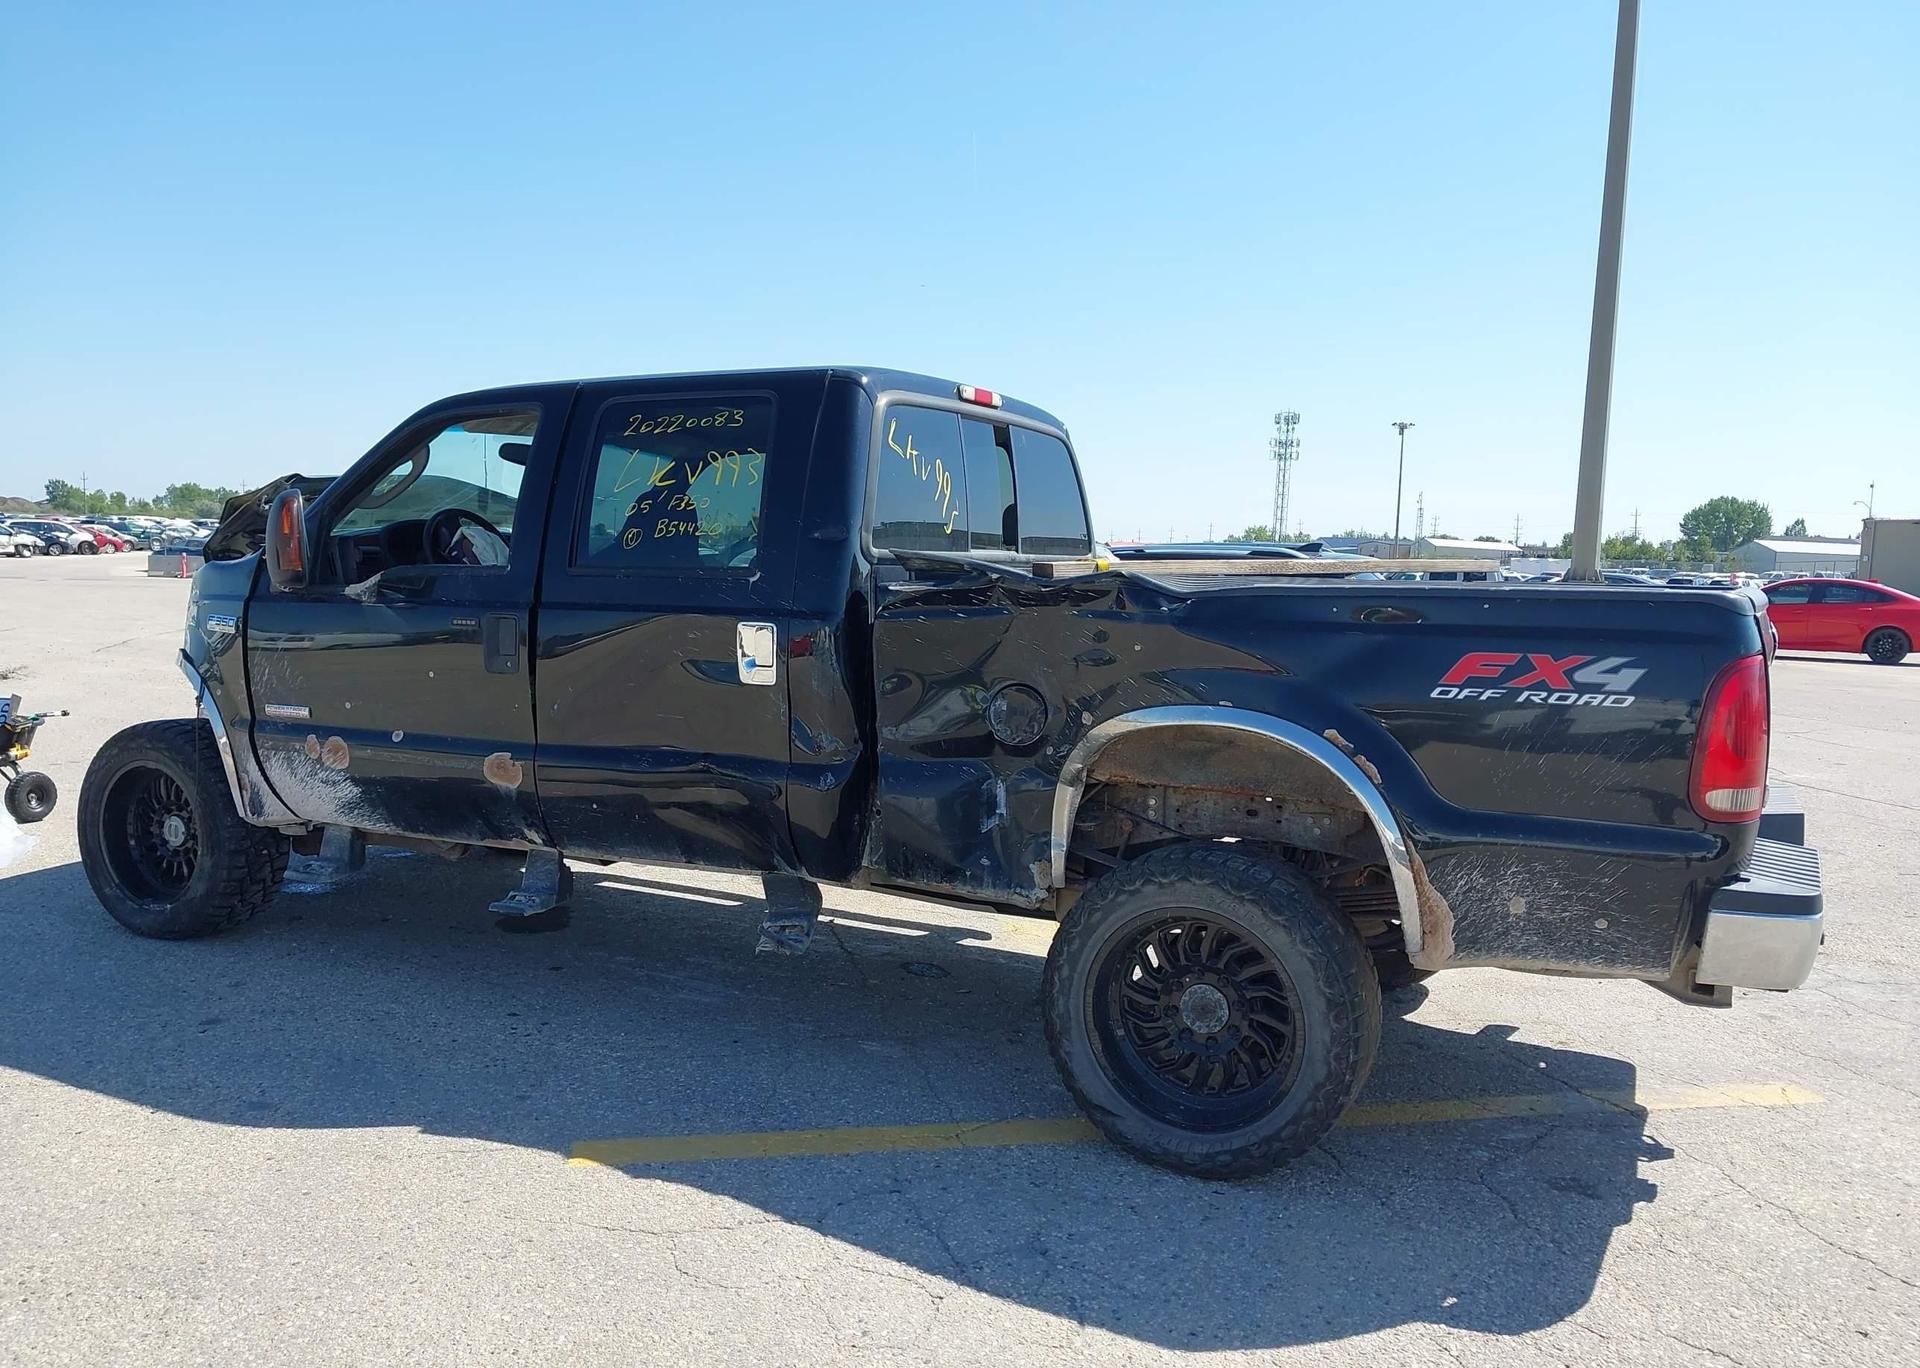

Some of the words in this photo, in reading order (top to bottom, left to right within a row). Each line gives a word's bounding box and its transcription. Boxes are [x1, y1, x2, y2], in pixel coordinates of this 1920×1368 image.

[623, 409, 744, 436] 20220083
[613, 447, 762, 493] LKV993
[667, 494, 711, 511] F350
[1437, 651, 1649, 692] FX4
[1429, 687, 1509, 700] OFF
[1514, 690, 1636, 708] ROAD
